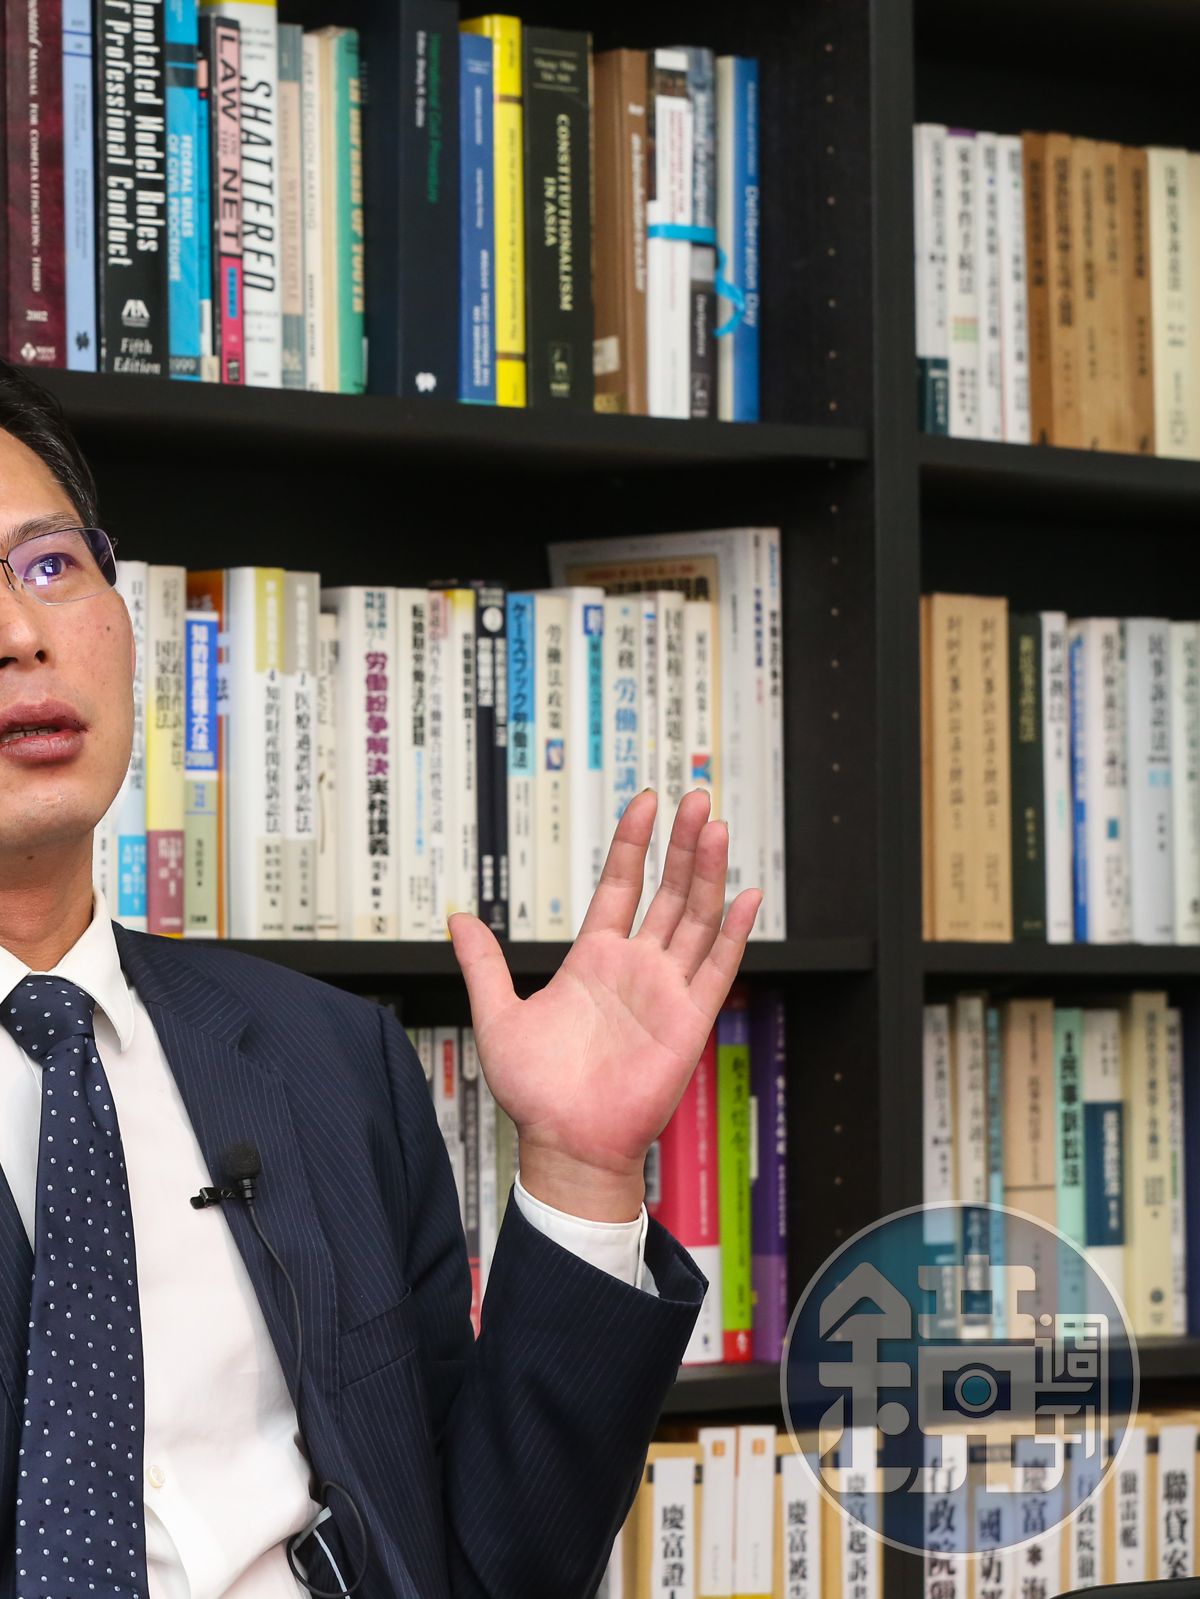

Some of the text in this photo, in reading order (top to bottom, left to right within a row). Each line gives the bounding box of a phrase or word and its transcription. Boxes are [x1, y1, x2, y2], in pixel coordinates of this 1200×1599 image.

[29, 48, 40, 96] MANUAL
[219, 33, 238, 121] LAW
[30, 129, 41, 181] COMPLEX
[105, 19, 134, 267] Professional Conduct
[135, 115, 165, 181] Model
[241, 75, 275, 293] SHATTERED
[30, 183, 42, 247] LITIGATION
[136, 190, 165, 252] Rules
[221, 167, 240, 249] NET
[544, 177, 557, 247] IN ASIA
[556, 113, 573, 312] CONSTITUTIONALISM
[745, 185, 759, 289] Deliberation
[113, 357, 161, 375] Edition
[120, 338, 153, 357] Fifth
[513, 602, 528, 769] ケースブック労働法
[547, 624, 561, 729] 労働法政策
[616, 625, 634, 670] 実務
[365, 652, 389, 856] 労働紛争解決実務講義
[661, 1503, 685, 1599] 慶富證
[1163, 1469, 1190, 1580] 聯貸案
